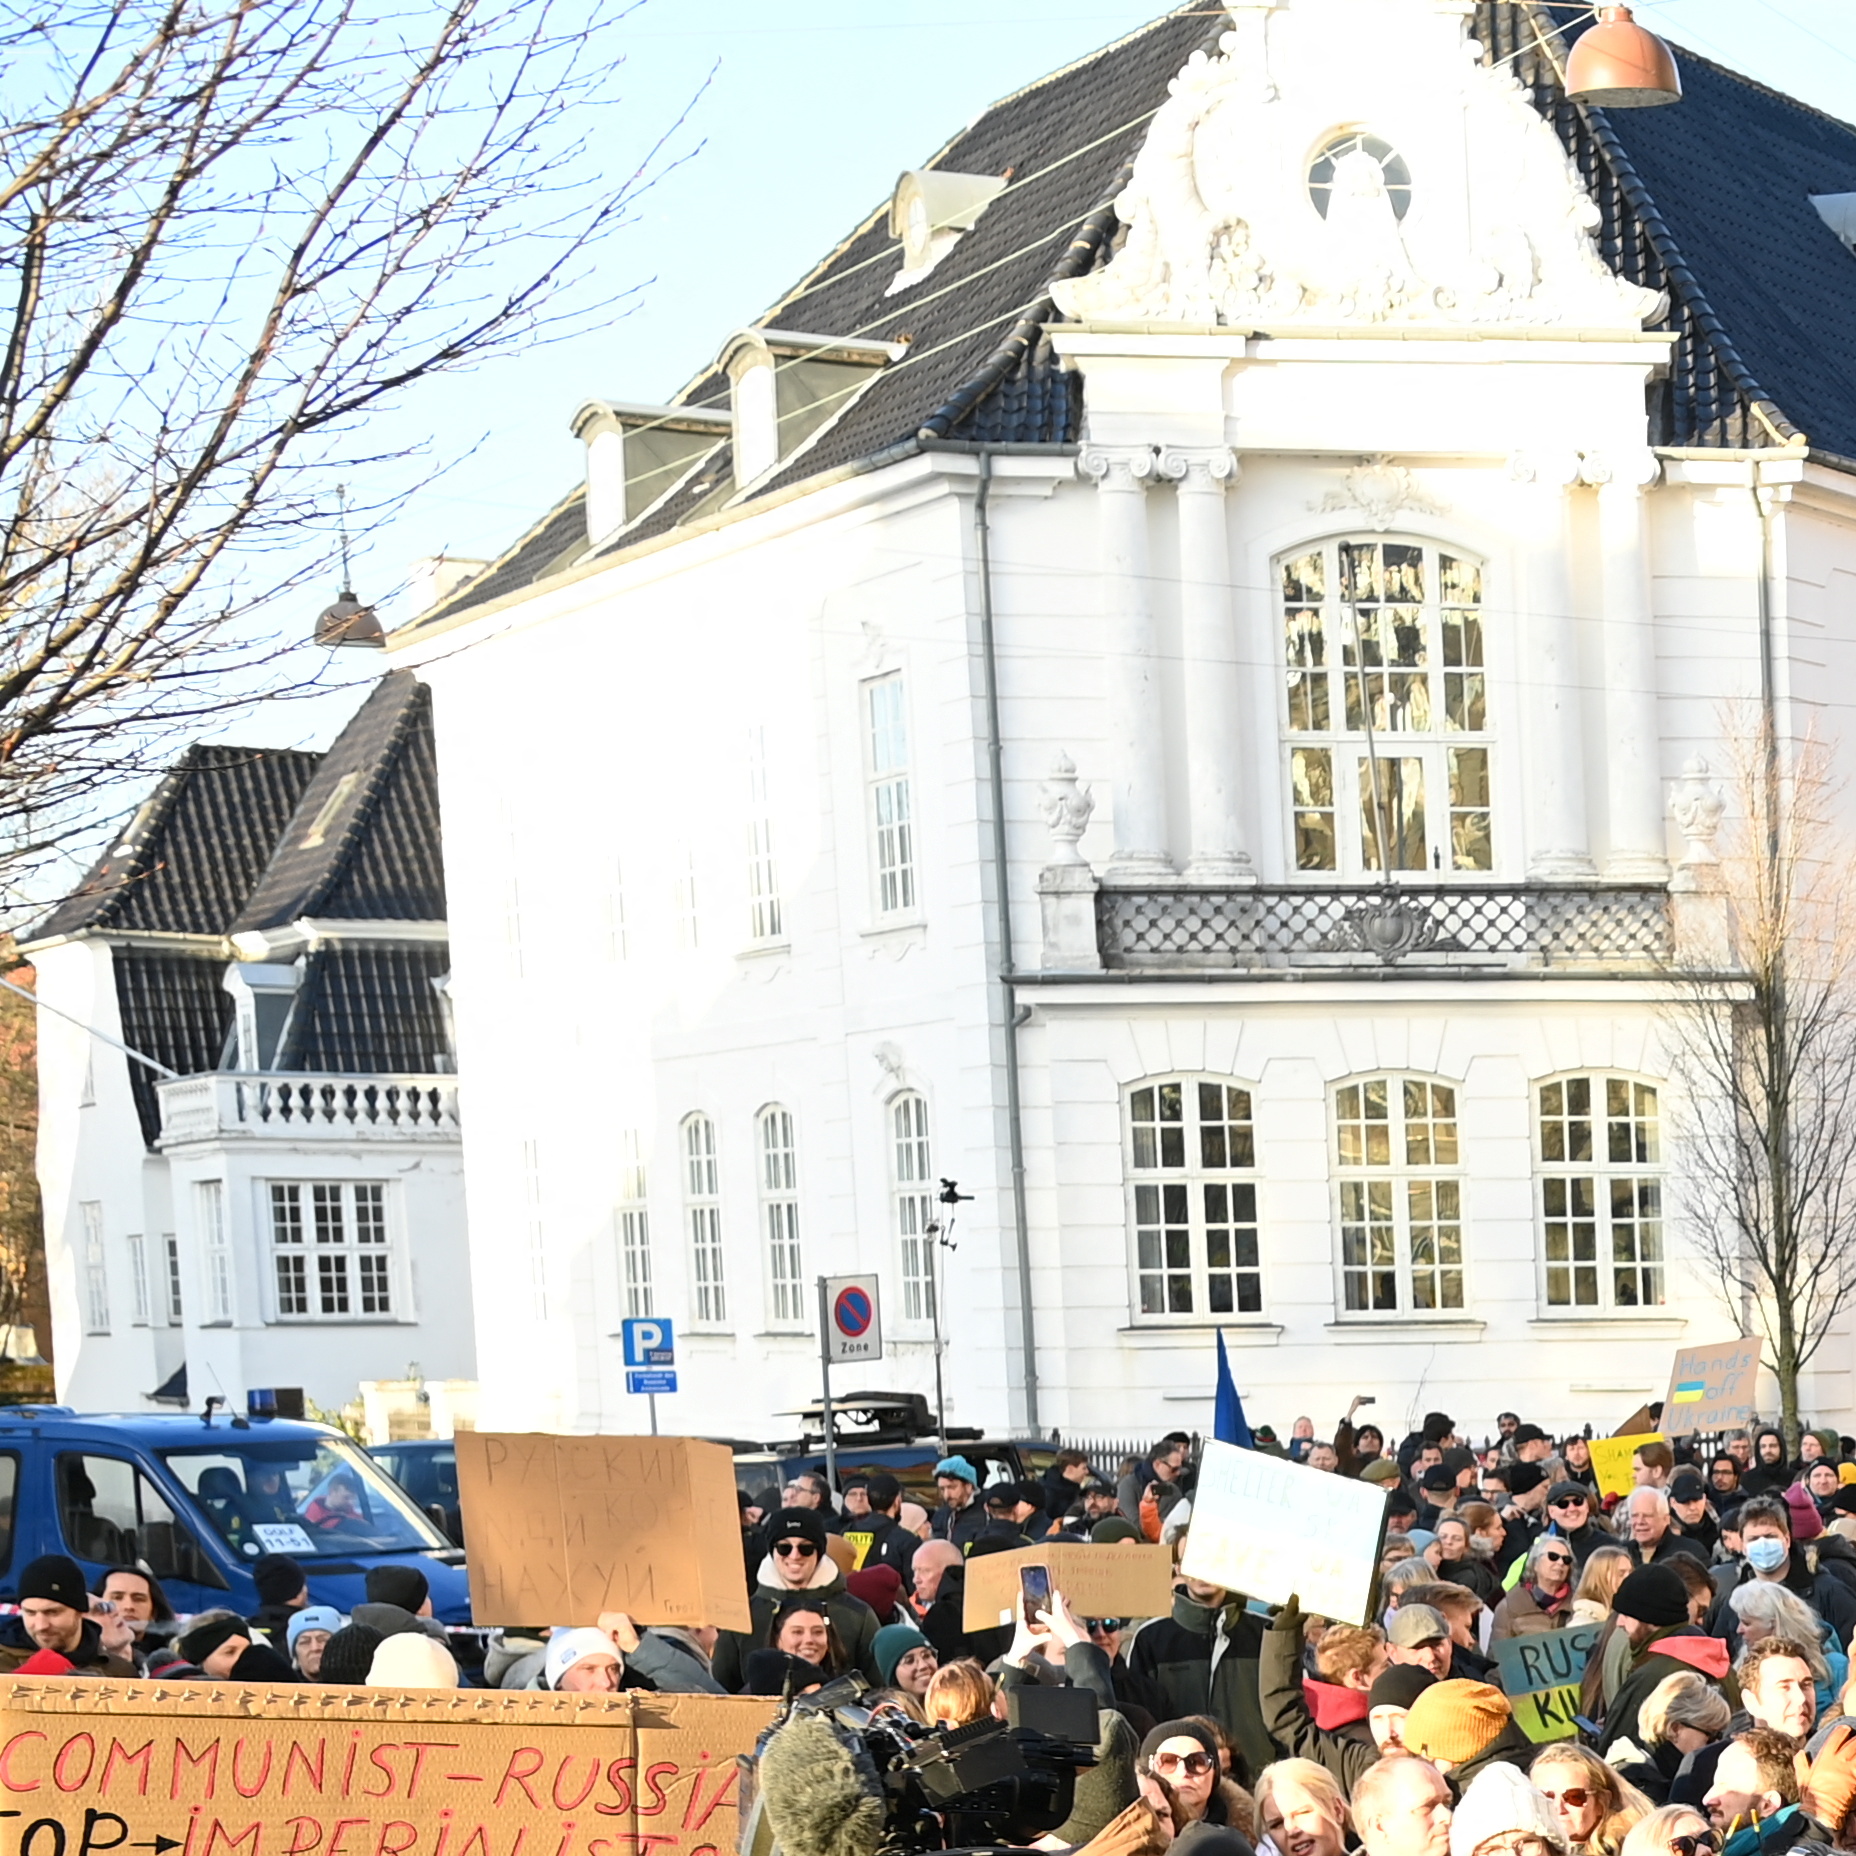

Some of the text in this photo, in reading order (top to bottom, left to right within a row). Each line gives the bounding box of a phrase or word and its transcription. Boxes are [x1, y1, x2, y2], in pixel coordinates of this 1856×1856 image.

[634, 1323, 663, 1363] P
[841, 1342, 869, 1354] Zone
[1679, 1349, 1752, 1375] Hands
[1705, 1371, 1744, 1400] off
[1668, 1405, 1754, 1432] Ukraine
[1519, 1630, 1601, 1686] RUS
